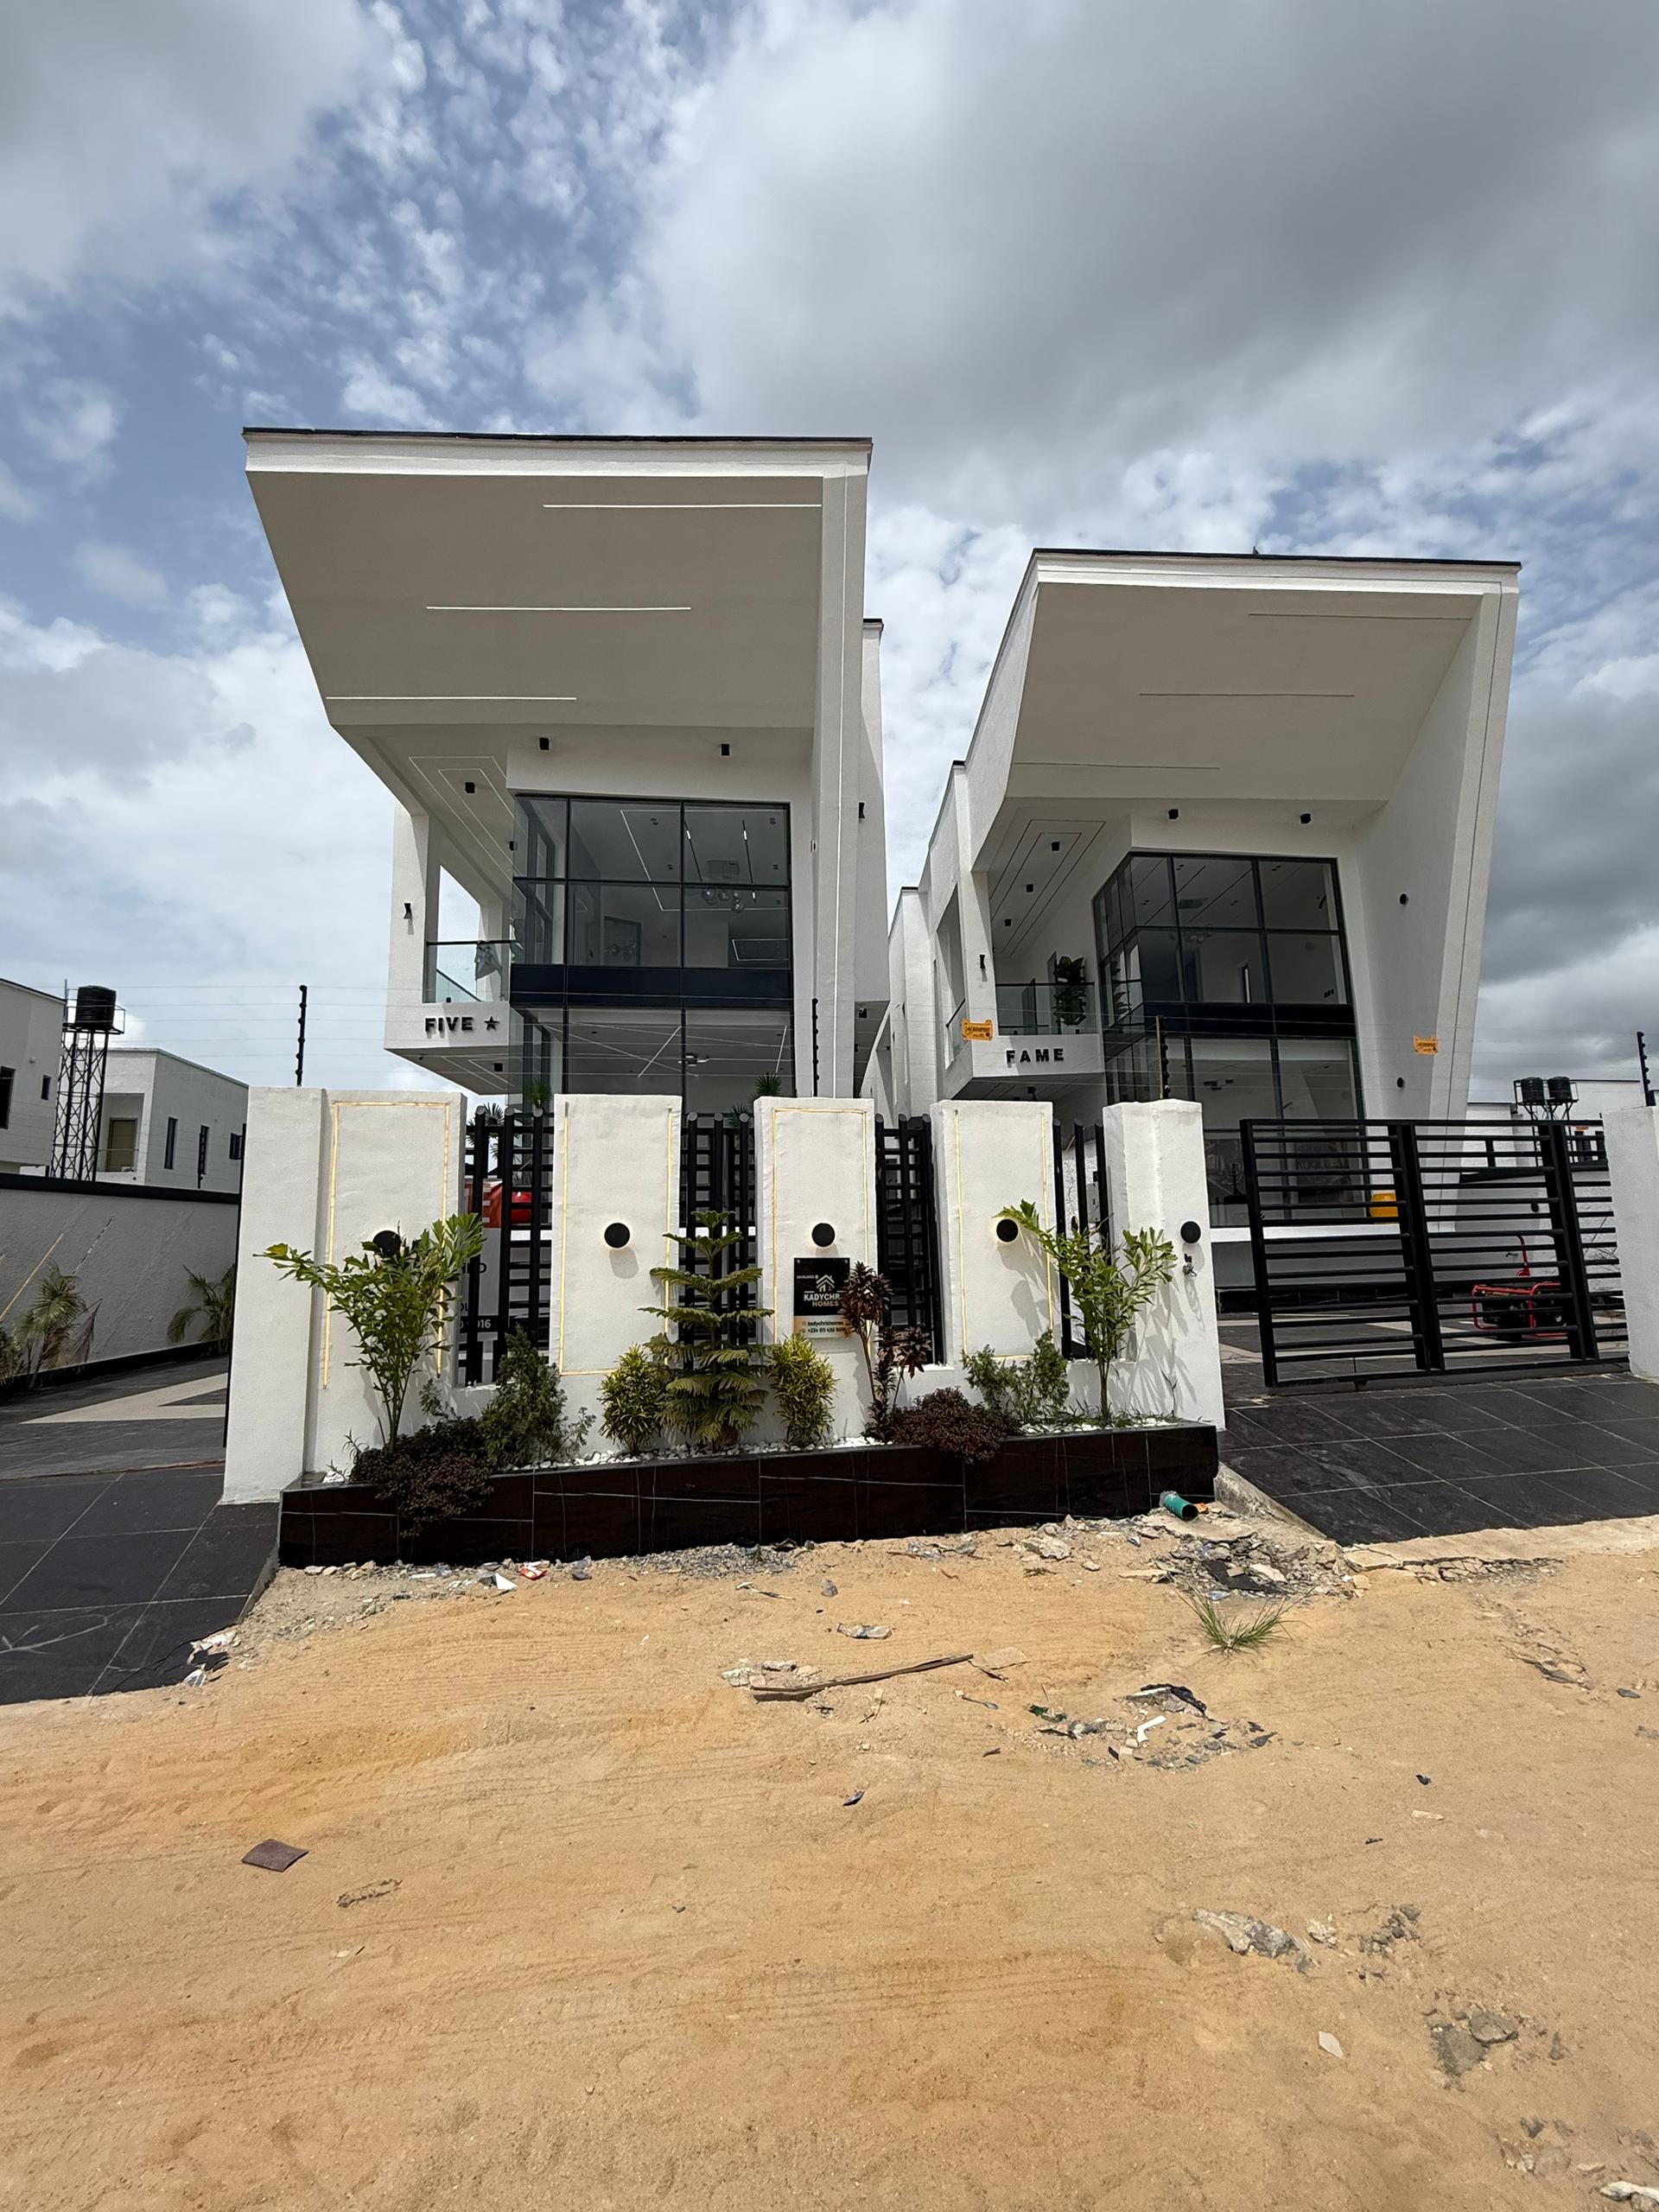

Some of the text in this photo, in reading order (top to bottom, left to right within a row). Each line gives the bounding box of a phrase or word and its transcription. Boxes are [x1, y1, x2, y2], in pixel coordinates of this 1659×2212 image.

[425, 1016, 474, 1032] FIVE
[1006, 1048, 1065, 1063] FAME
[804, 1293, 841, 1301] KADYCHR
